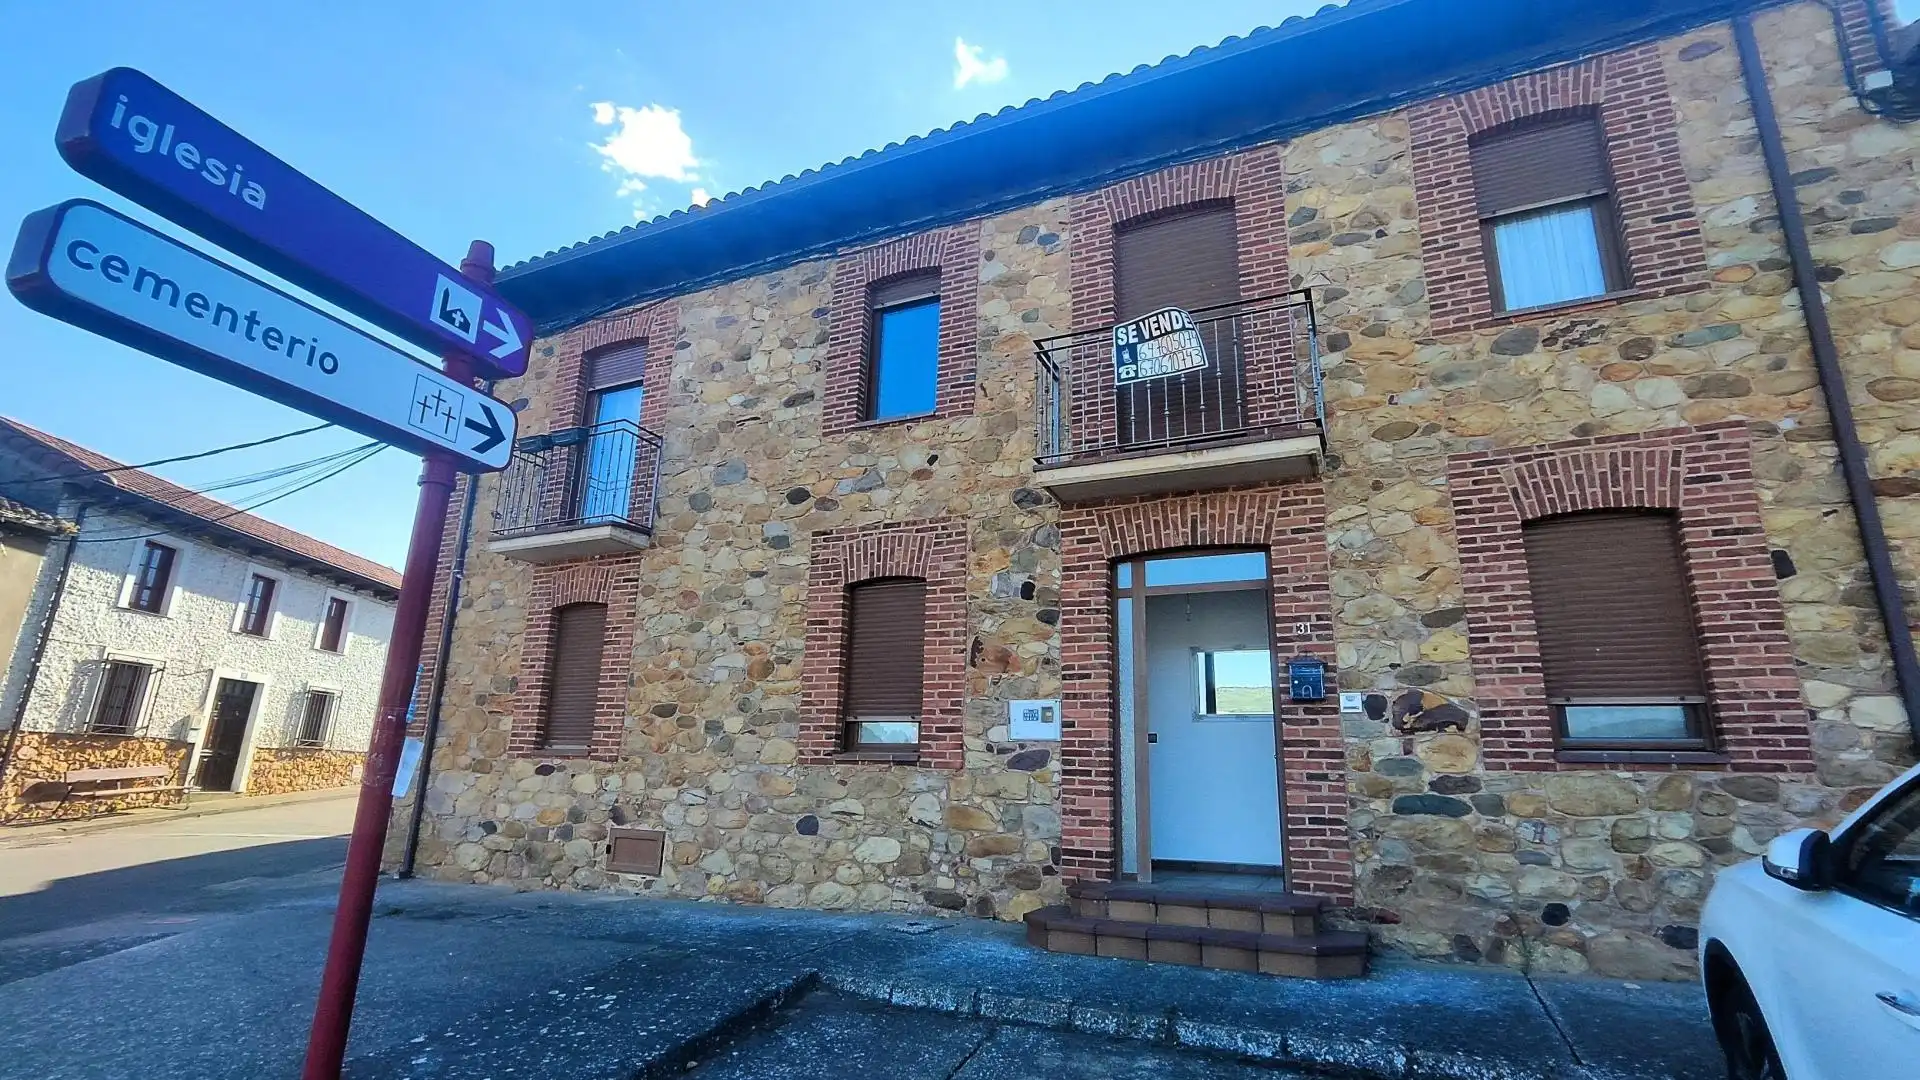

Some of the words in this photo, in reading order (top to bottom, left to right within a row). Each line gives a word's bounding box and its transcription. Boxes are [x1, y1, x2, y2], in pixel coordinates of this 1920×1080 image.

[109, 94, 267, 211] iglesia
[66, 238, 340, 376] cementerio
[1117, 324, 1139, 346] SE
[1139, 310, 1194, 340] VENDE
[1296, 622, 1311, 634] 31
